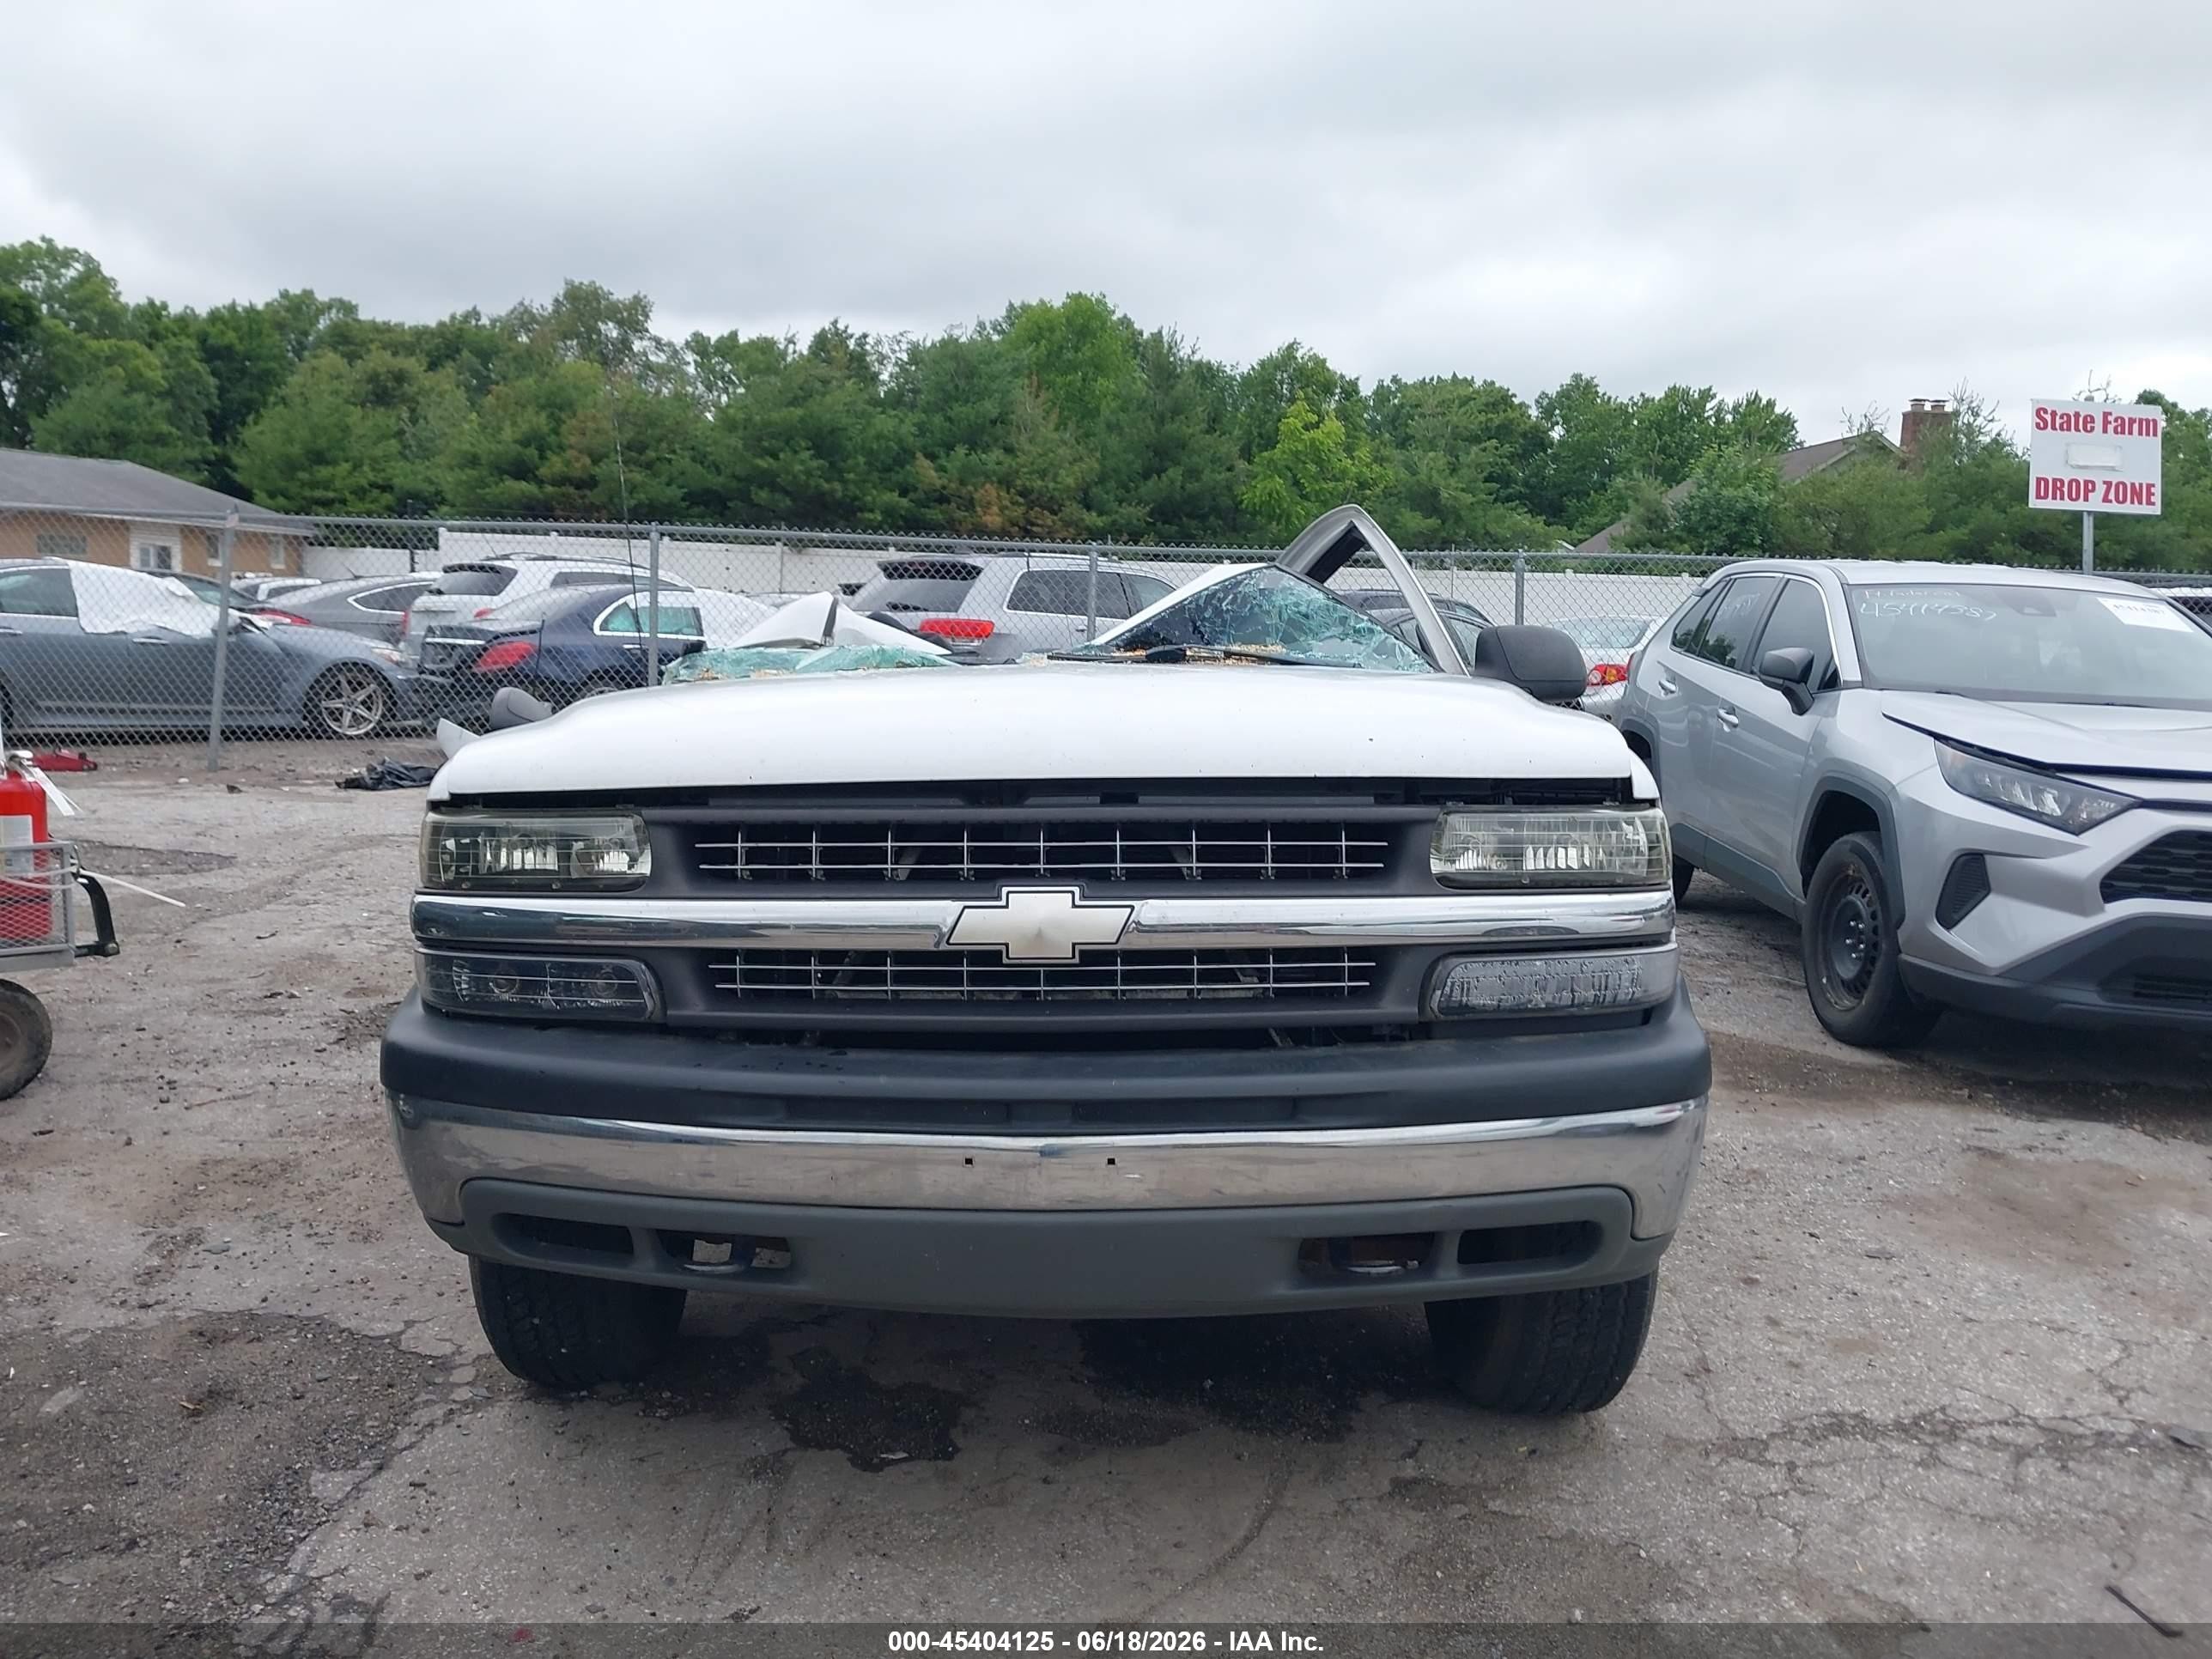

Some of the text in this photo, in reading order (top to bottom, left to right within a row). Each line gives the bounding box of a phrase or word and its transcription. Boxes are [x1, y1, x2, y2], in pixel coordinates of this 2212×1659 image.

[2034, 406, 2159, 438] State Farm
[2034, 477, 2156, 507] DROP ZONE
